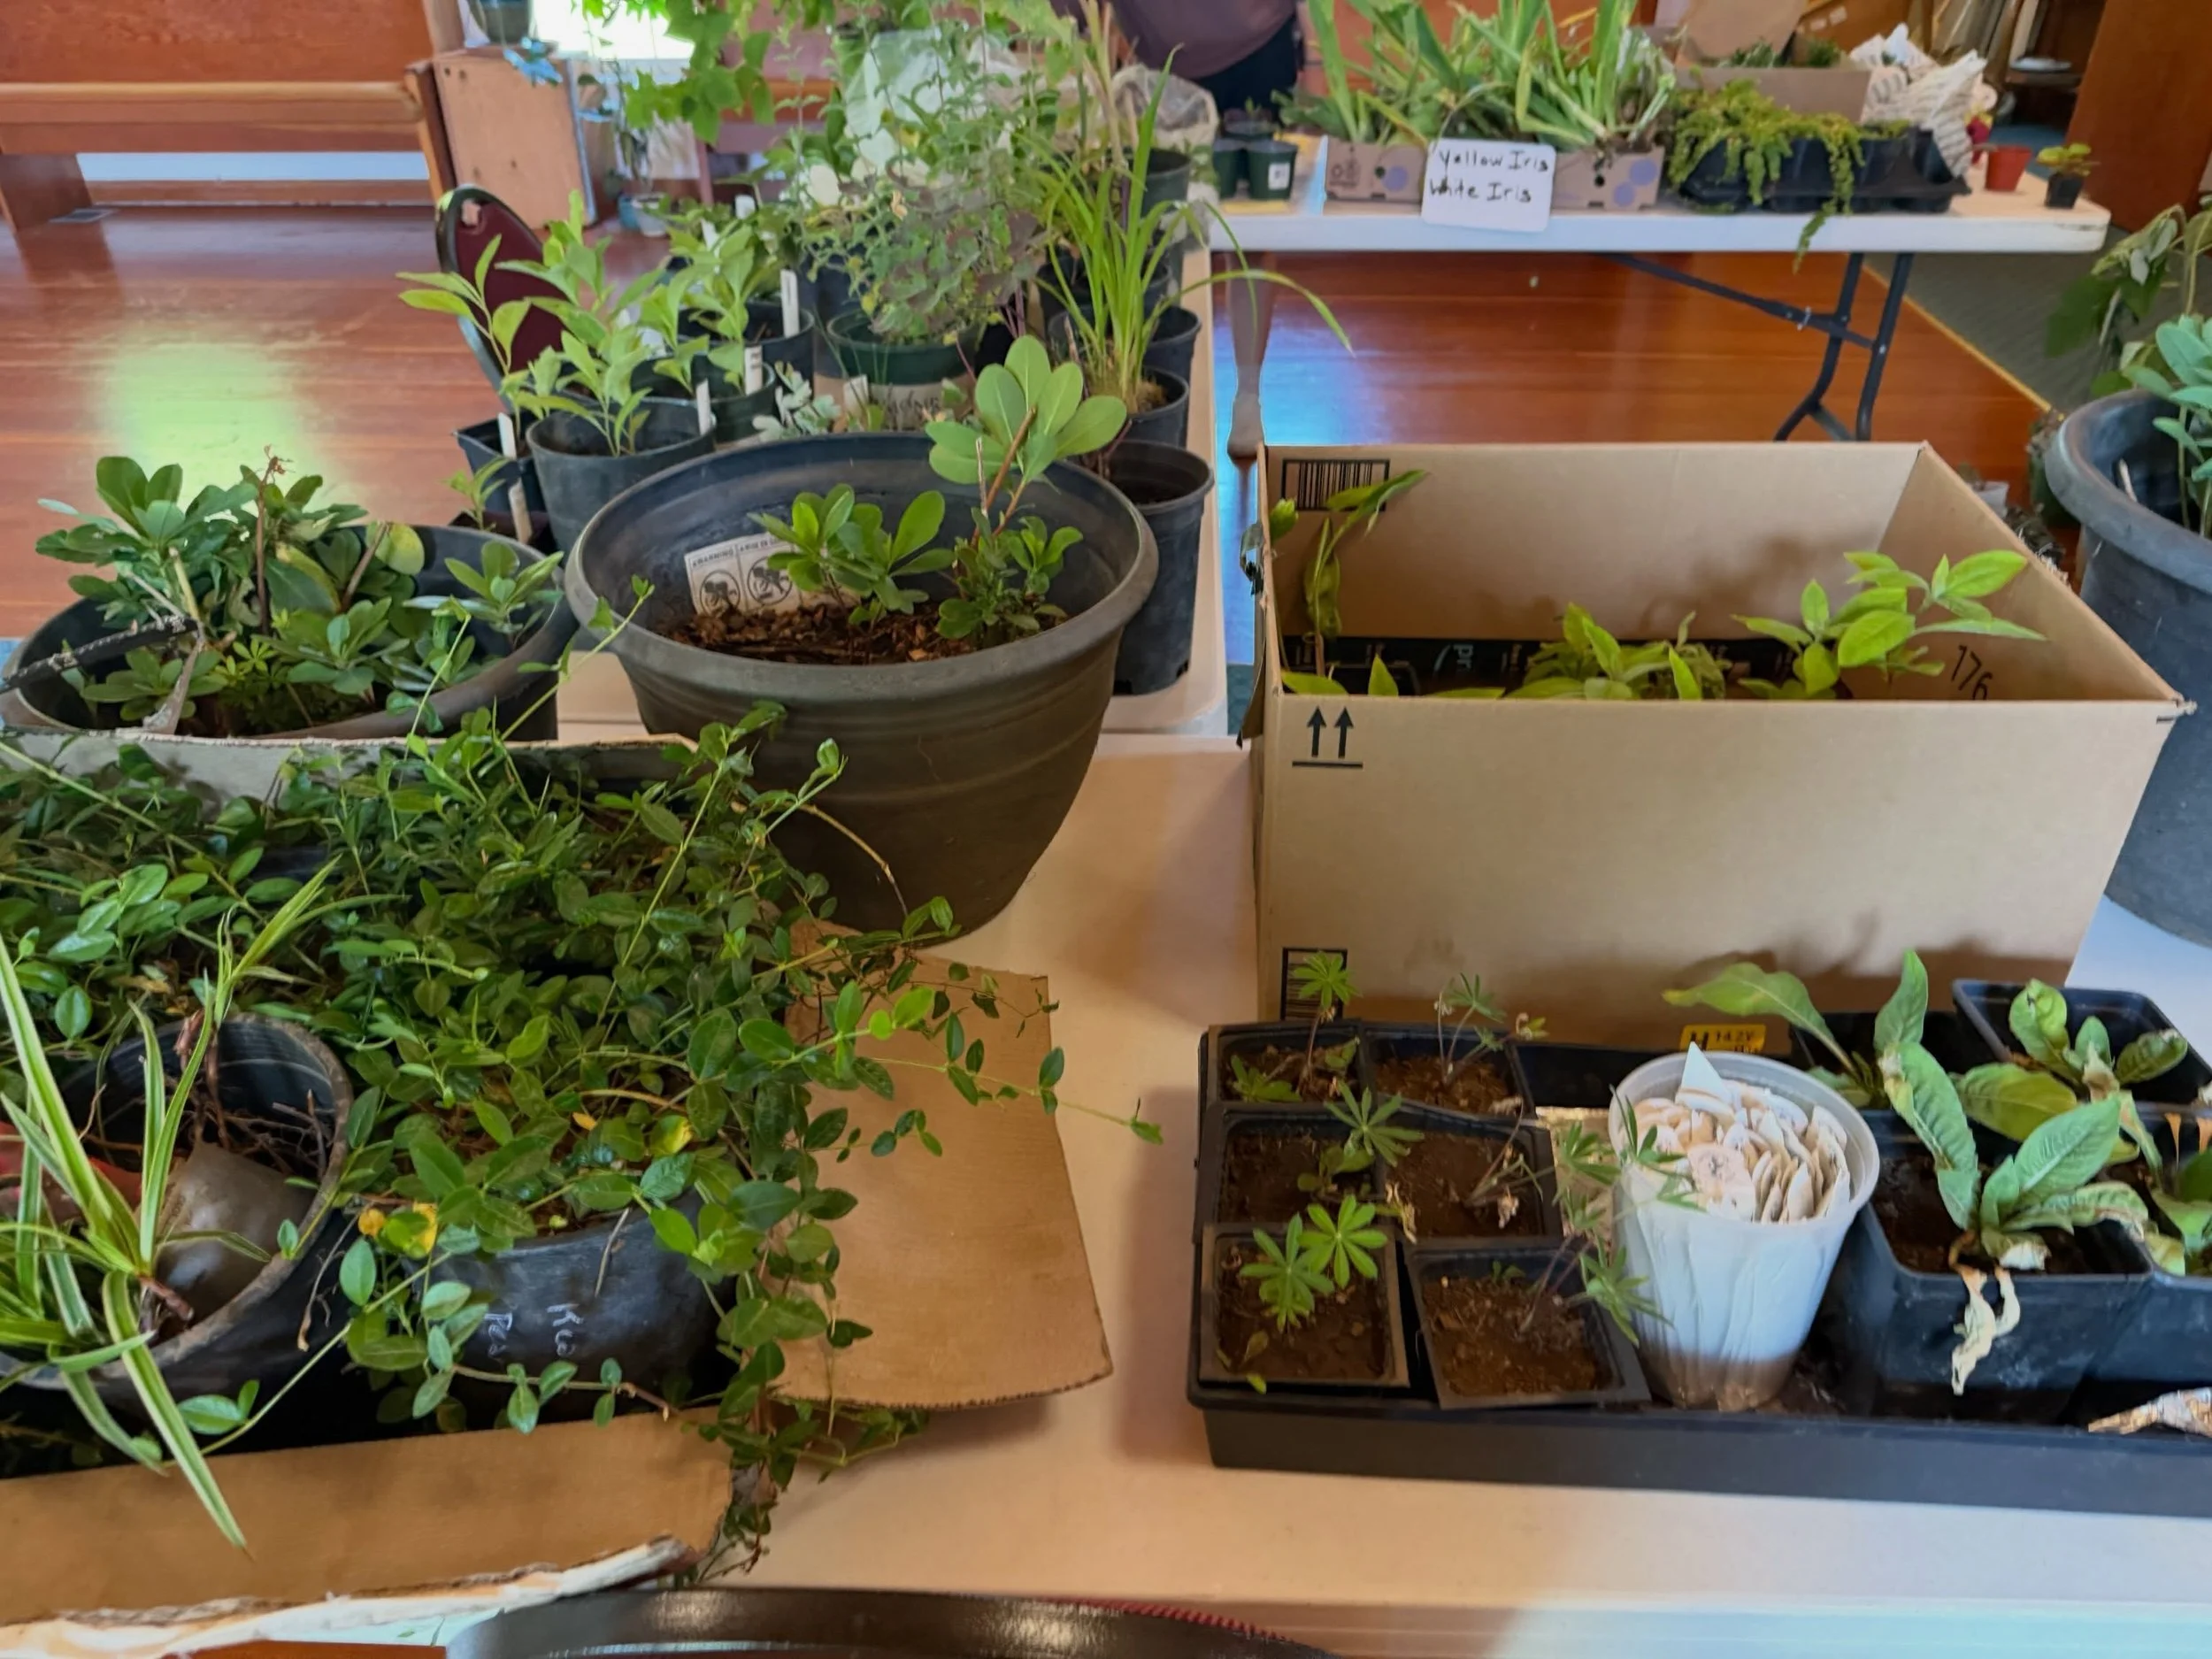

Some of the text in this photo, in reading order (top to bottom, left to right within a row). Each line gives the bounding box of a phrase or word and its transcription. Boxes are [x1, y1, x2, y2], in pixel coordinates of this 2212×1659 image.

[1439, 150, 1548, 174] Yellow Iris
[1486, 181, 1532, 203] Iris
